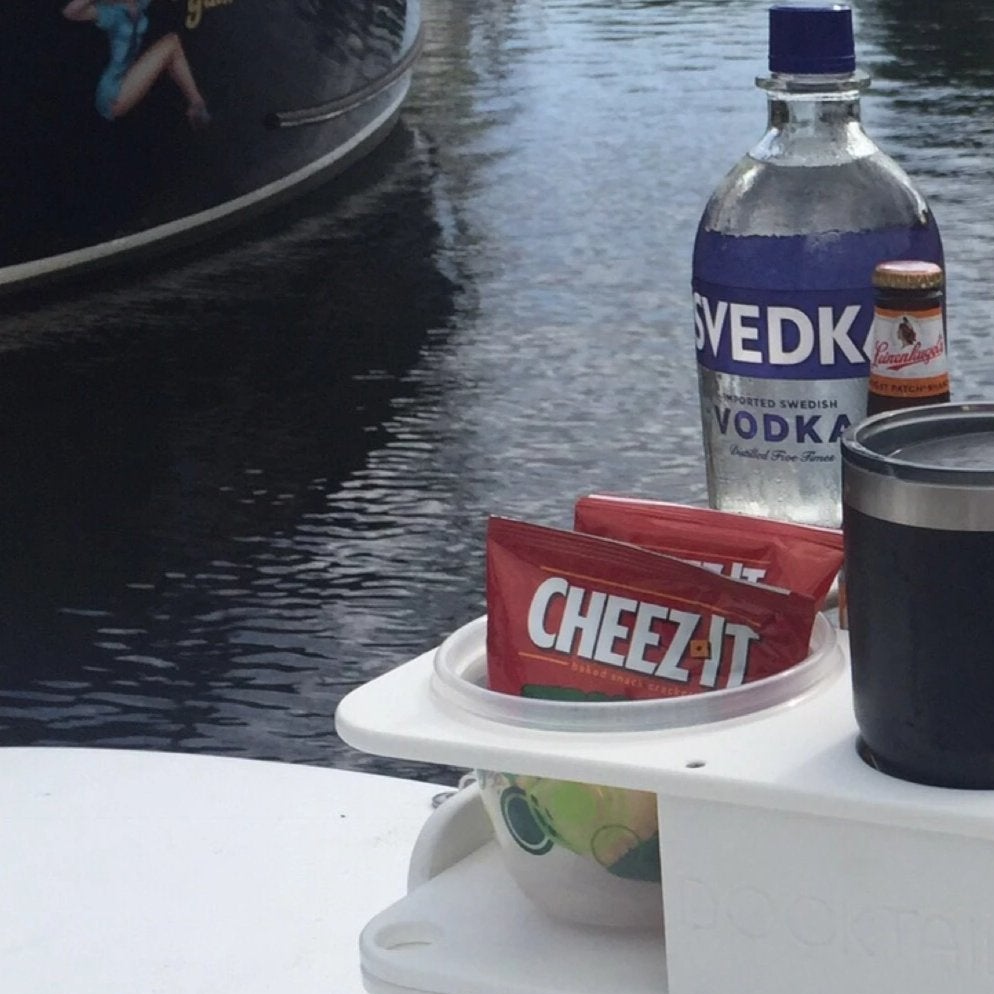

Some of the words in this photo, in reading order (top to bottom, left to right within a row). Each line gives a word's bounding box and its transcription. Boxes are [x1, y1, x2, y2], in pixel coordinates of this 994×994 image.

[693, 291, 875, 365] SVEDK
[779, 399, 838, 409] SWEDISH
[714, 404, 852, 443] VODKA
[571, 660, 608, 679] baked
[611, 672, 644, 688] snack
